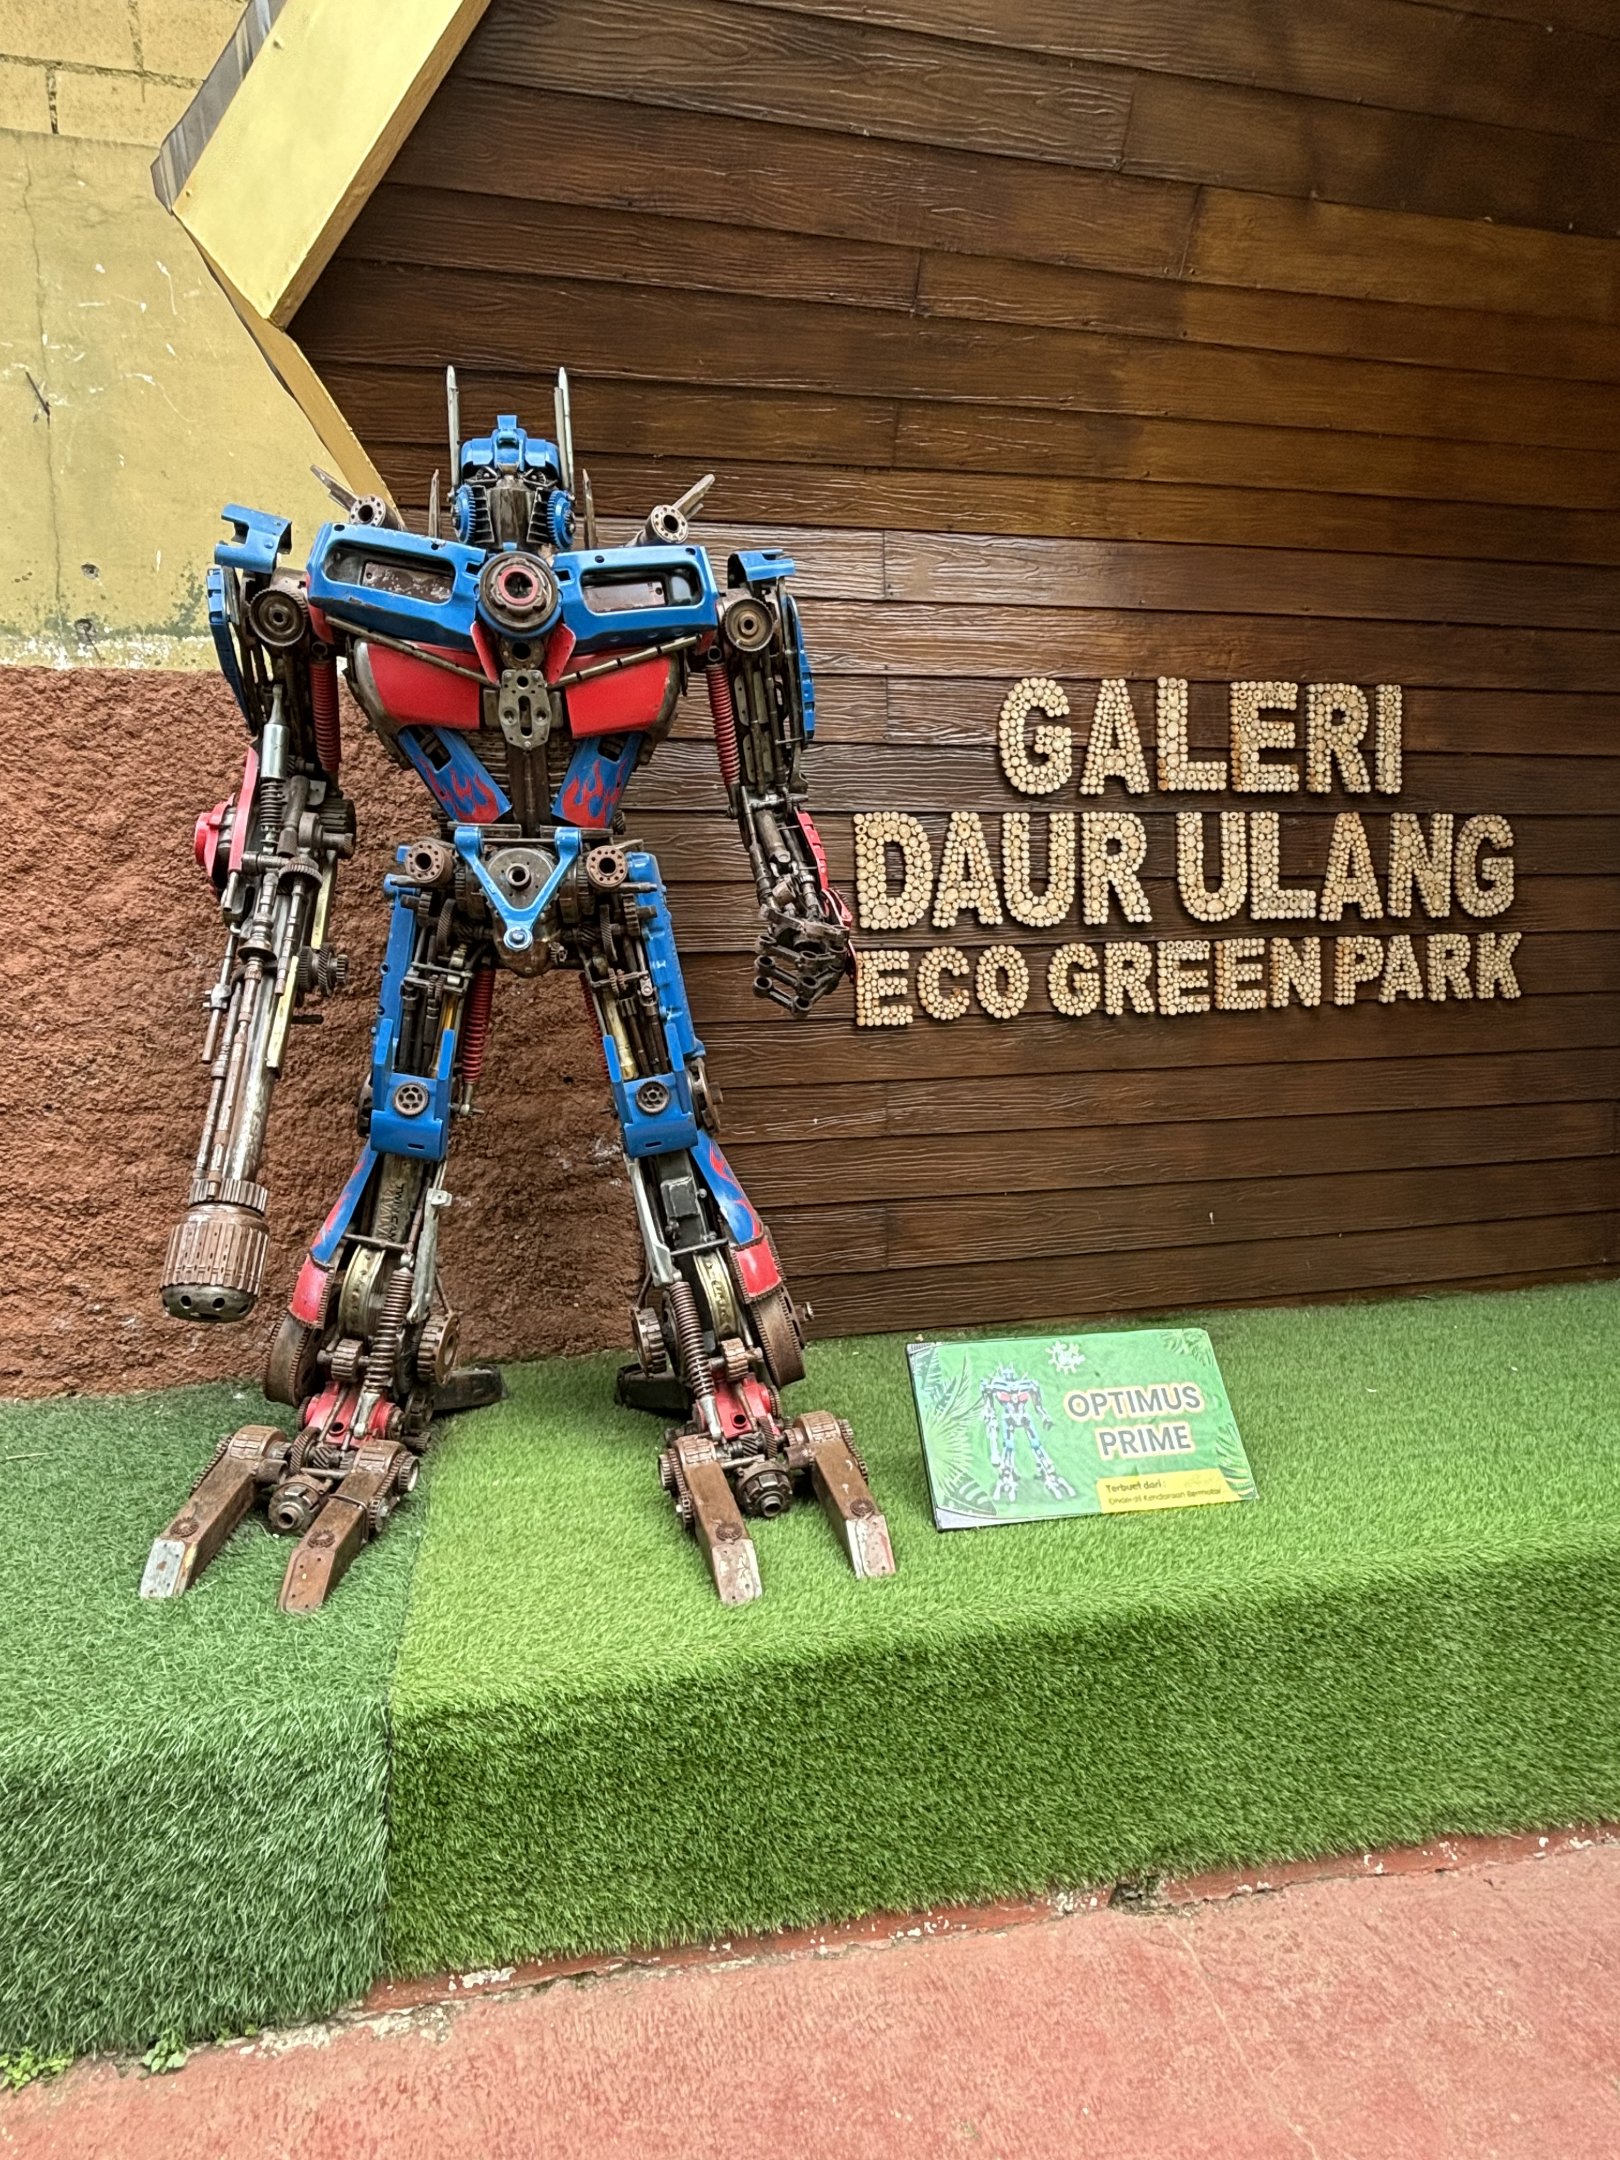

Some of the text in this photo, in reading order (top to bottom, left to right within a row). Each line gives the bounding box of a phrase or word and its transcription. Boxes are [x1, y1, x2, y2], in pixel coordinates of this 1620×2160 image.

[999, 676, 1403, 795] GALERI
[854, 811, 1515, 930] DAUR ULANG
[856, 932, 1522, 1027] ECO GREEN PARK
[1067, 1385, 1201, 1418] OPTIMUS
[1098, 1425, 1192, 1456] PRIME
[1143, 1479, 1162, 1490] dari
